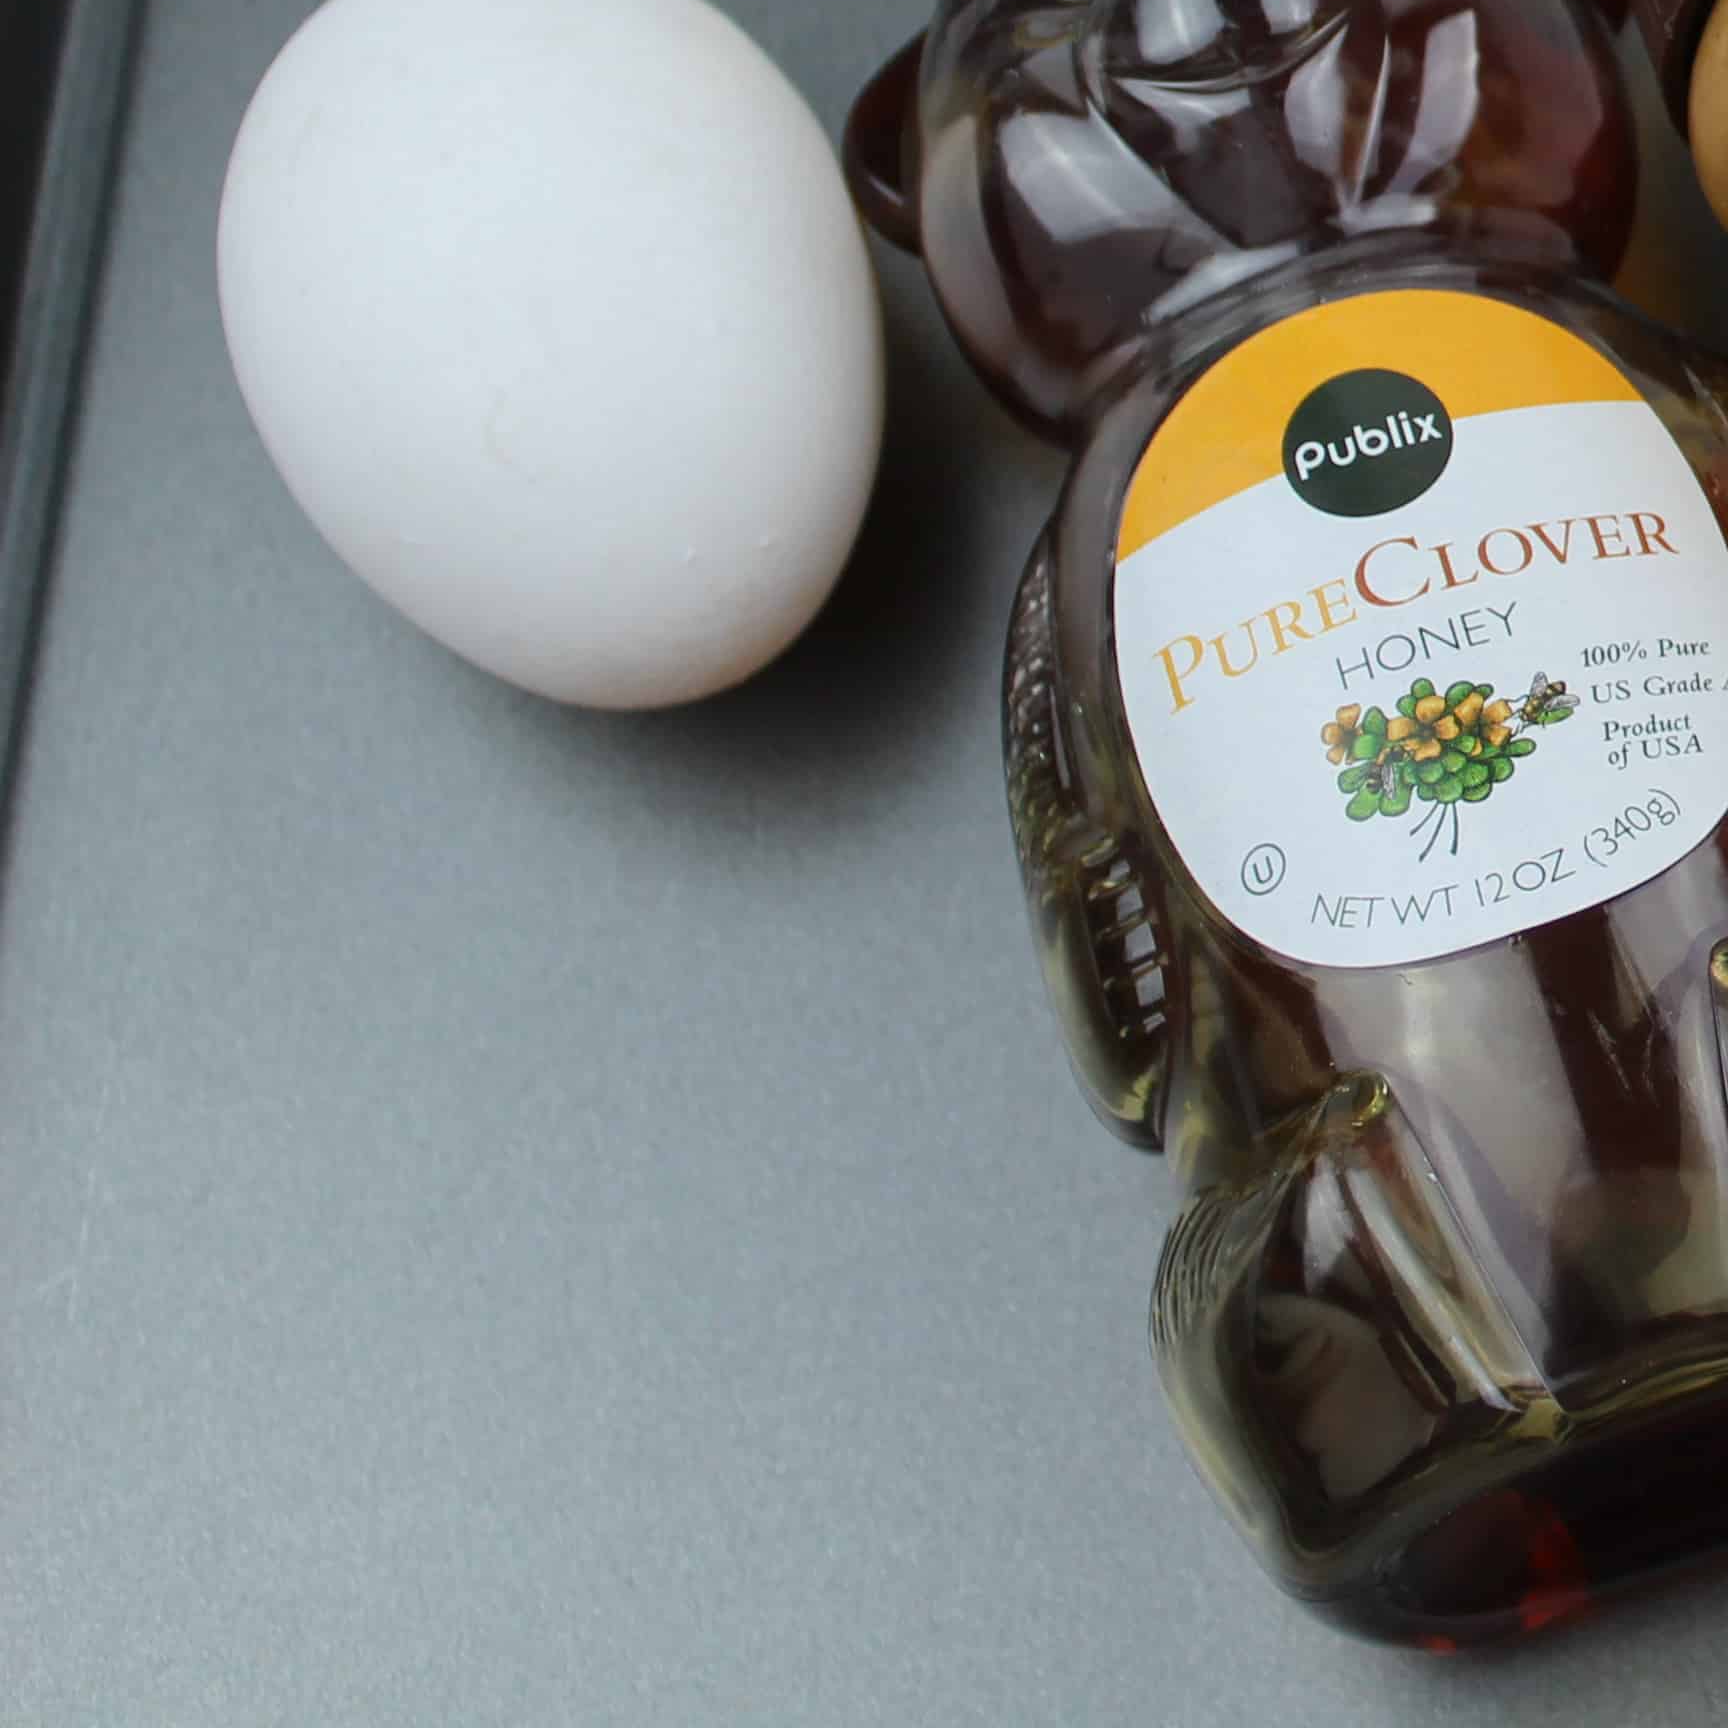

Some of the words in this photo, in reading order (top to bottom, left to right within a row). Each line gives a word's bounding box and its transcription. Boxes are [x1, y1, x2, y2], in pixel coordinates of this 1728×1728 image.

[1293, 411, 1443, 482] Publix
[1336, 601, 1519, 691] HONEY
[1580, 639, 1648, 668] 100%
[1657, 636, 1711, 658] Pure
[1591, 678, 1632, 705] US
[1643, 671, 1713, 697] Grade
[1602, 713, 1692, 742] Product
[1608, 741, 1631, 770] of
[1641, 732, 1704, 760] USA
[1311, 892, 1384, 929] NET
[1390, 882, 1461, 925] WT
[1583, 788, 1682, 868] (340g)
